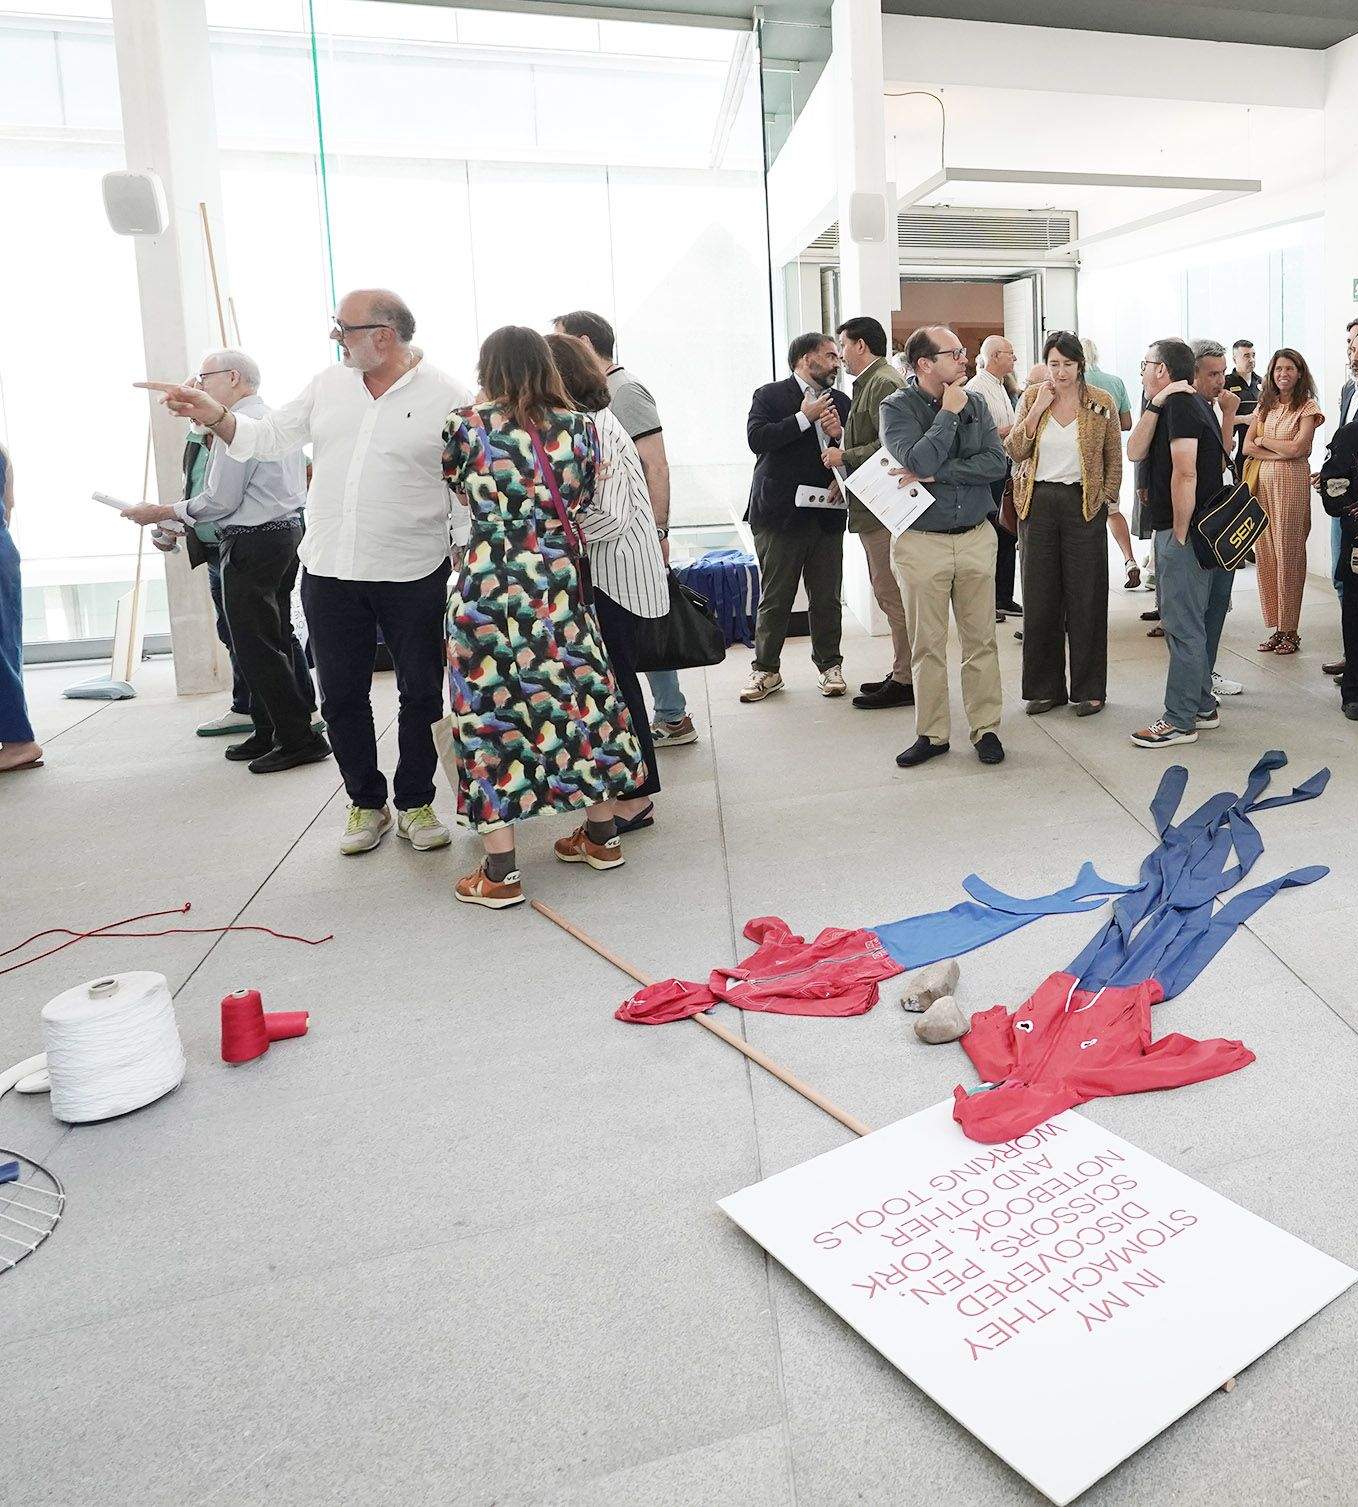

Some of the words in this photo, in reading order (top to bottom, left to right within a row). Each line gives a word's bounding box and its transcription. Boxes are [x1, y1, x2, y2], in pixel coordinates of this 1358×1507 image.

[929, 1122, 1067, 1191] WORKING
[992, 1154, 1053, 1190] AND
[813, 1190, 933, 1249] TOOLS
[881, 1189, 990, 1247] OTHER
[949, 1150, 1125, 1241] NOTEBOOK,
[979, 1175, 1137, 1258] SCISSORS,
[851, 1240, 954, 1299] FORK
[899, 1258, 985, 1305] PEN,
[957, 1201, 1151, 1316] DISCOVERED
[1048, 1209, 1198, 1302] STOMACH
[1121, 1268, 1165, 1297] IN
[963, 1300, 1056, 1361] THEY
[1076, 1291, 1130, 1332] MY
